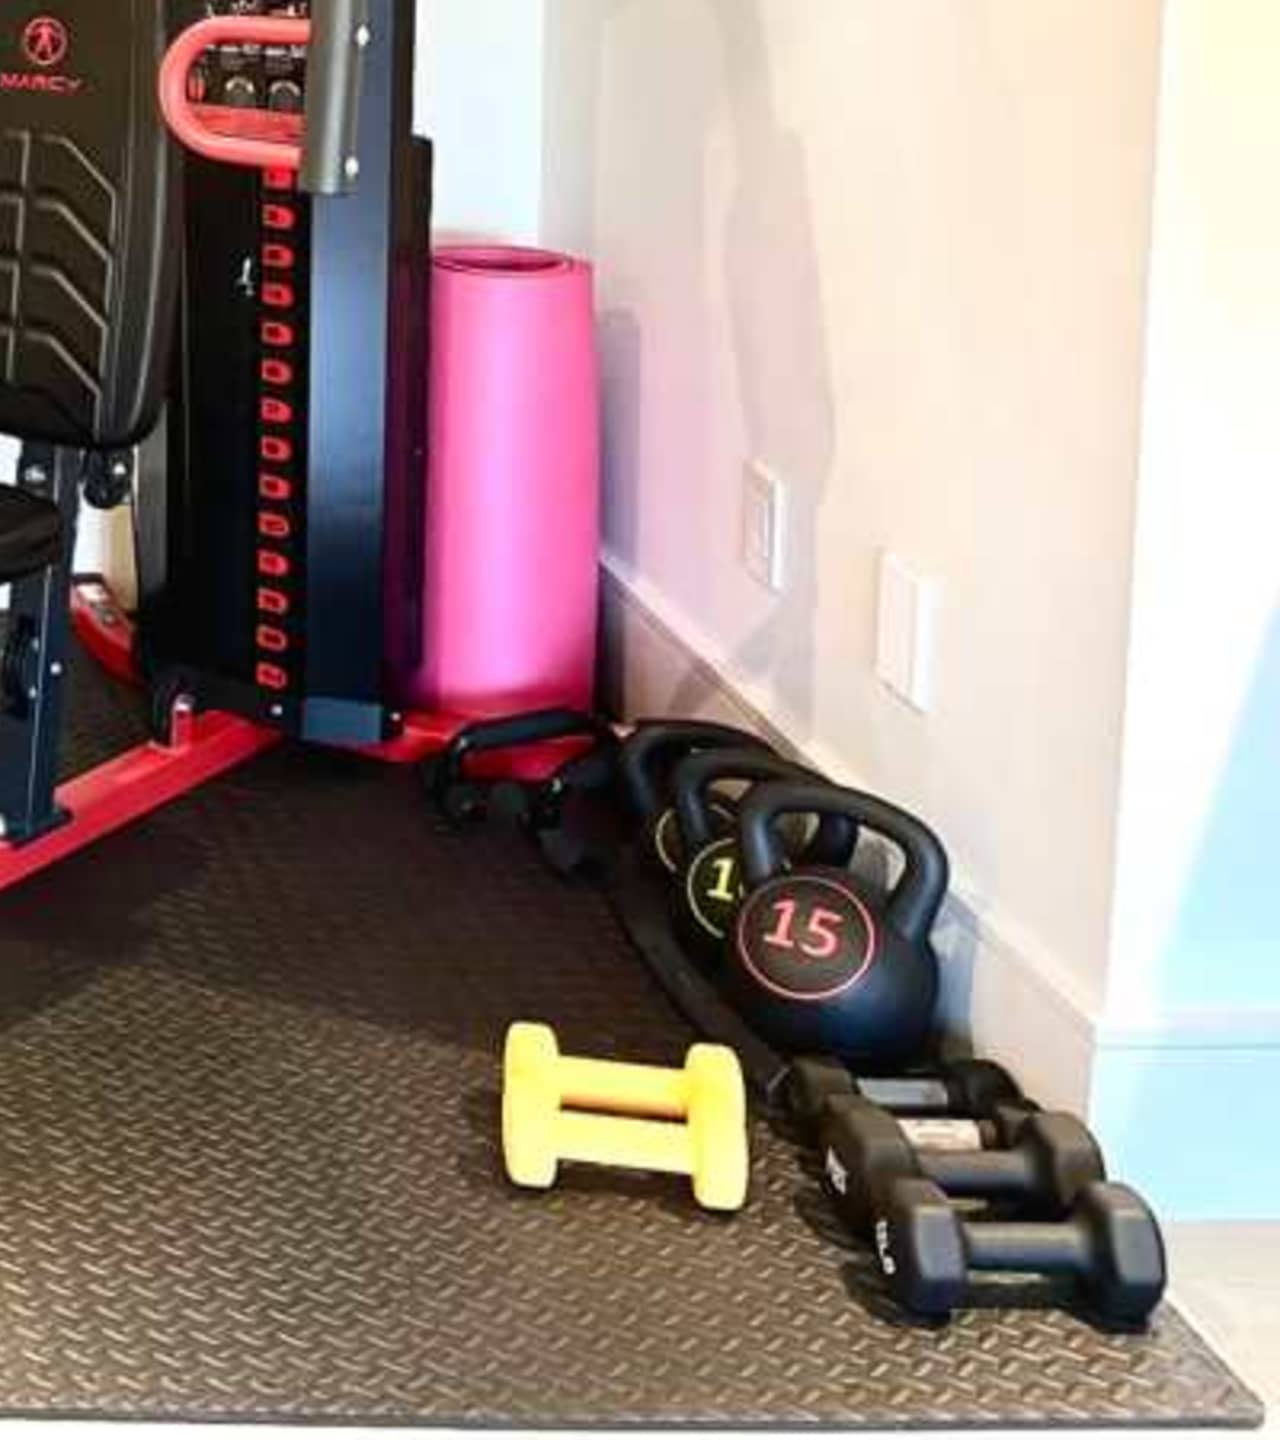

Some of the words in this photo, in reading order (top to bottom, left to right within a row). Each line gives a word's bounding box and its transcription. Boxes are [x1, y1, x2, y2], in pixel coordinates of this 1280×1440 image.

[0, 72, 82, 93] MARCY
[706, 857, 744, 901] 1
[763, 898, 843, 957] 15
